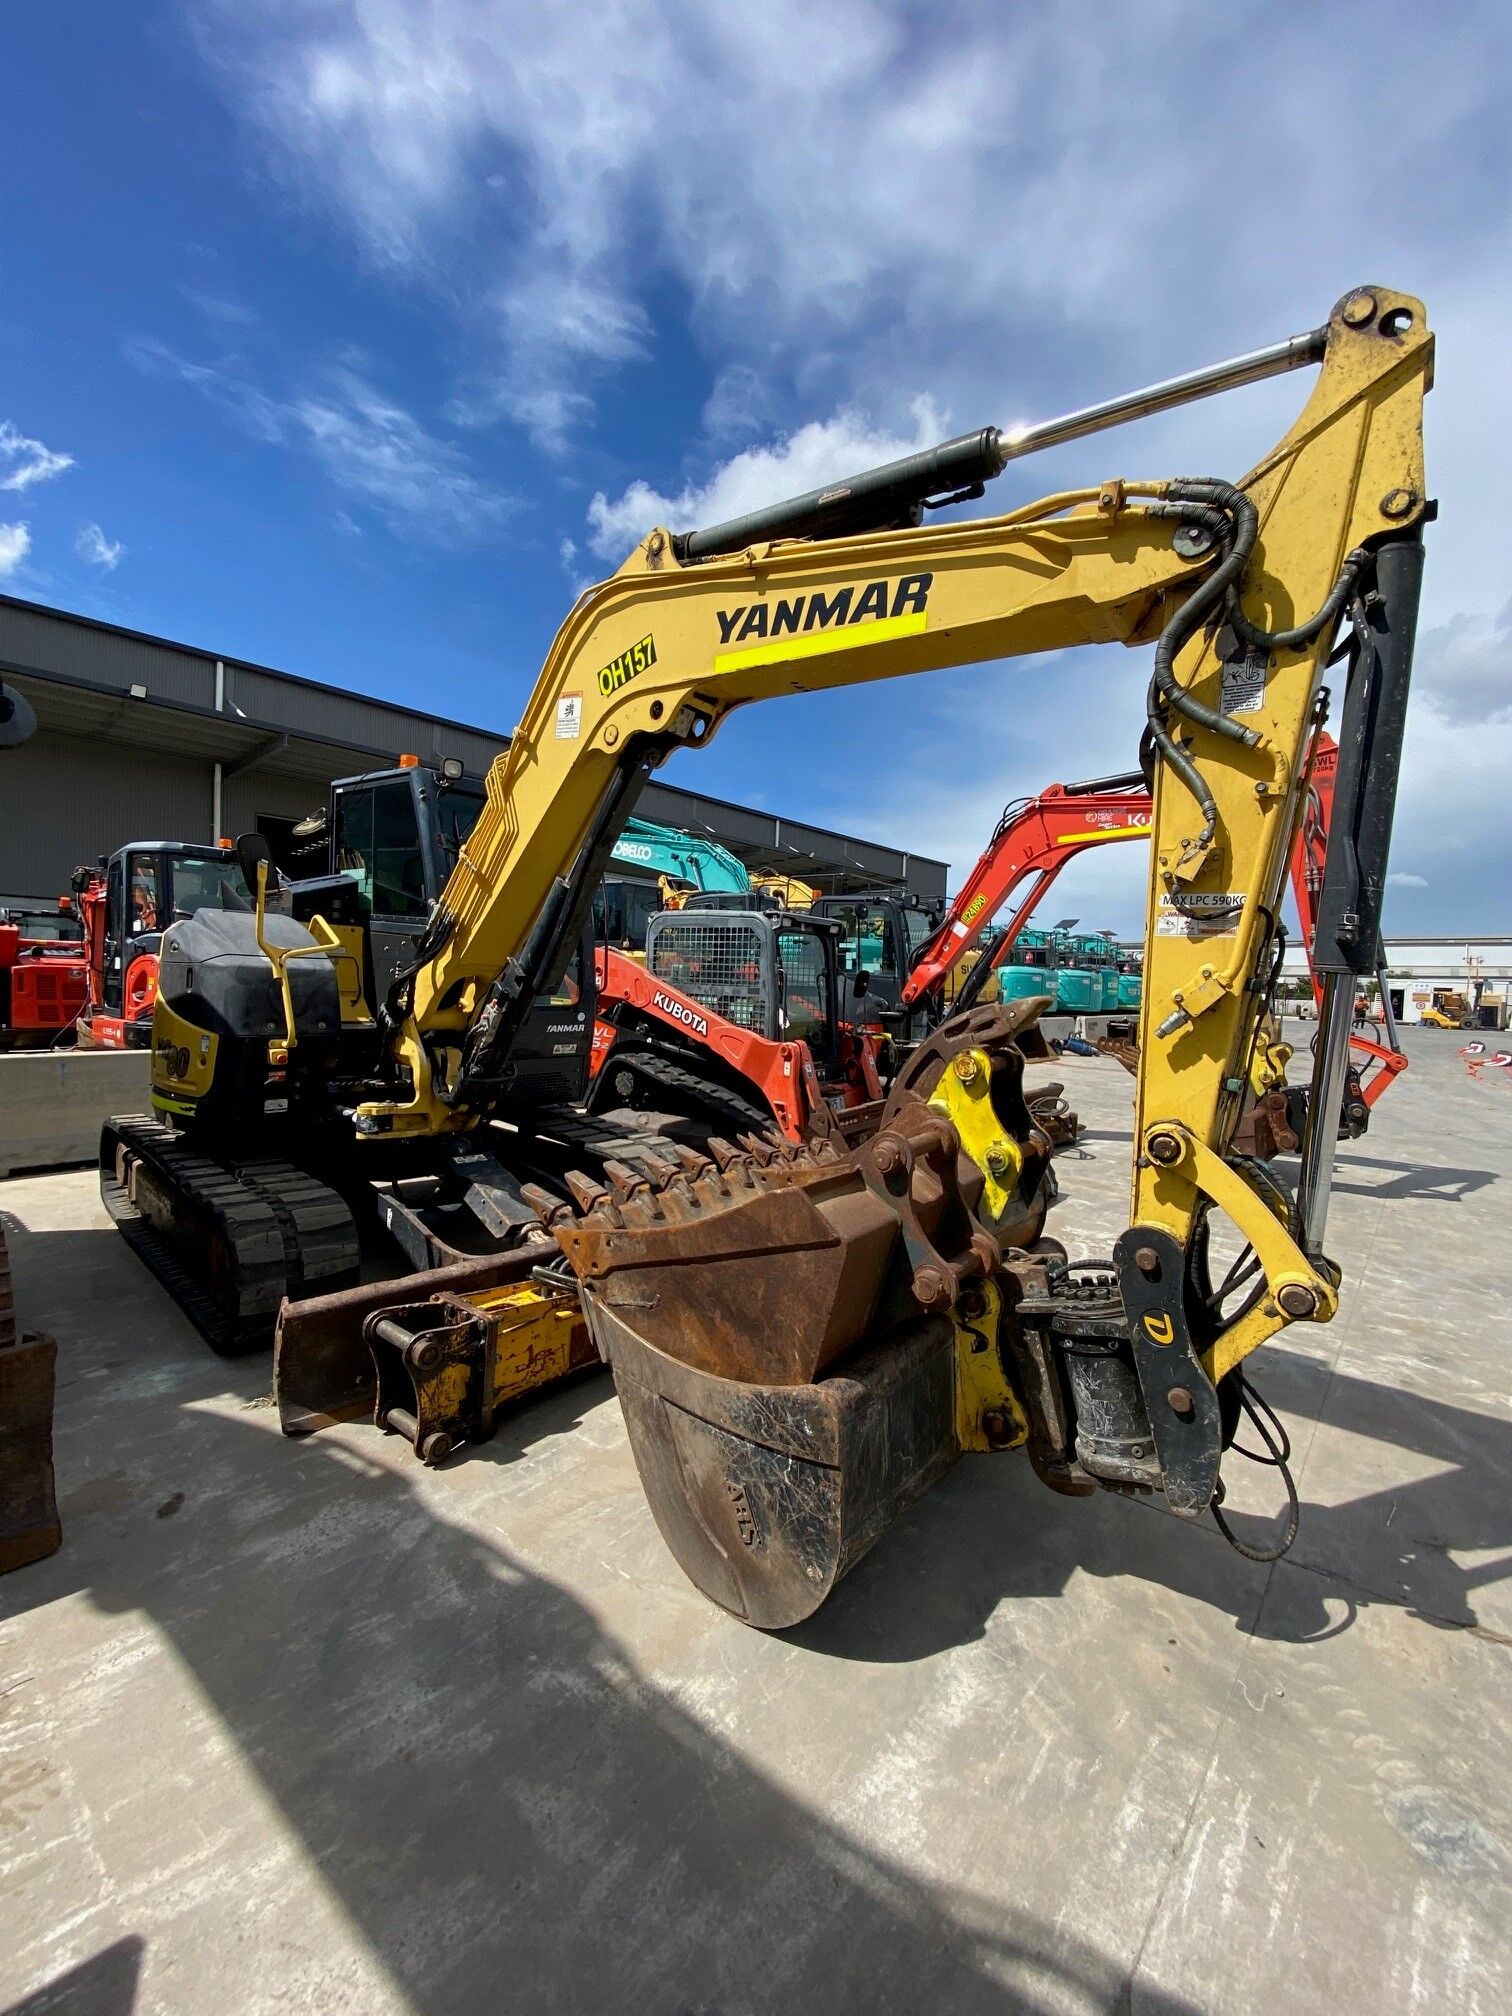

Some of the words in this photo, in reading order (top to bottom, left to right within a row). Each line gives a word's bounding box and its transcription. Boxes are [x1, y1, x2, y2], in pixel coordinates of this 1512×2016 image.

[716, 572, 934, 644] YANMAR
[599, 636, 653, 696] OH157
[613, 841, 652, 861] OBELCO
[1163, 895, 1187, 905] MAX
[1189, 895, 1210, 906] LPC
[653, 990, 708, 1037] KUBOTA
[593, 1026, 613, 1038] VL
